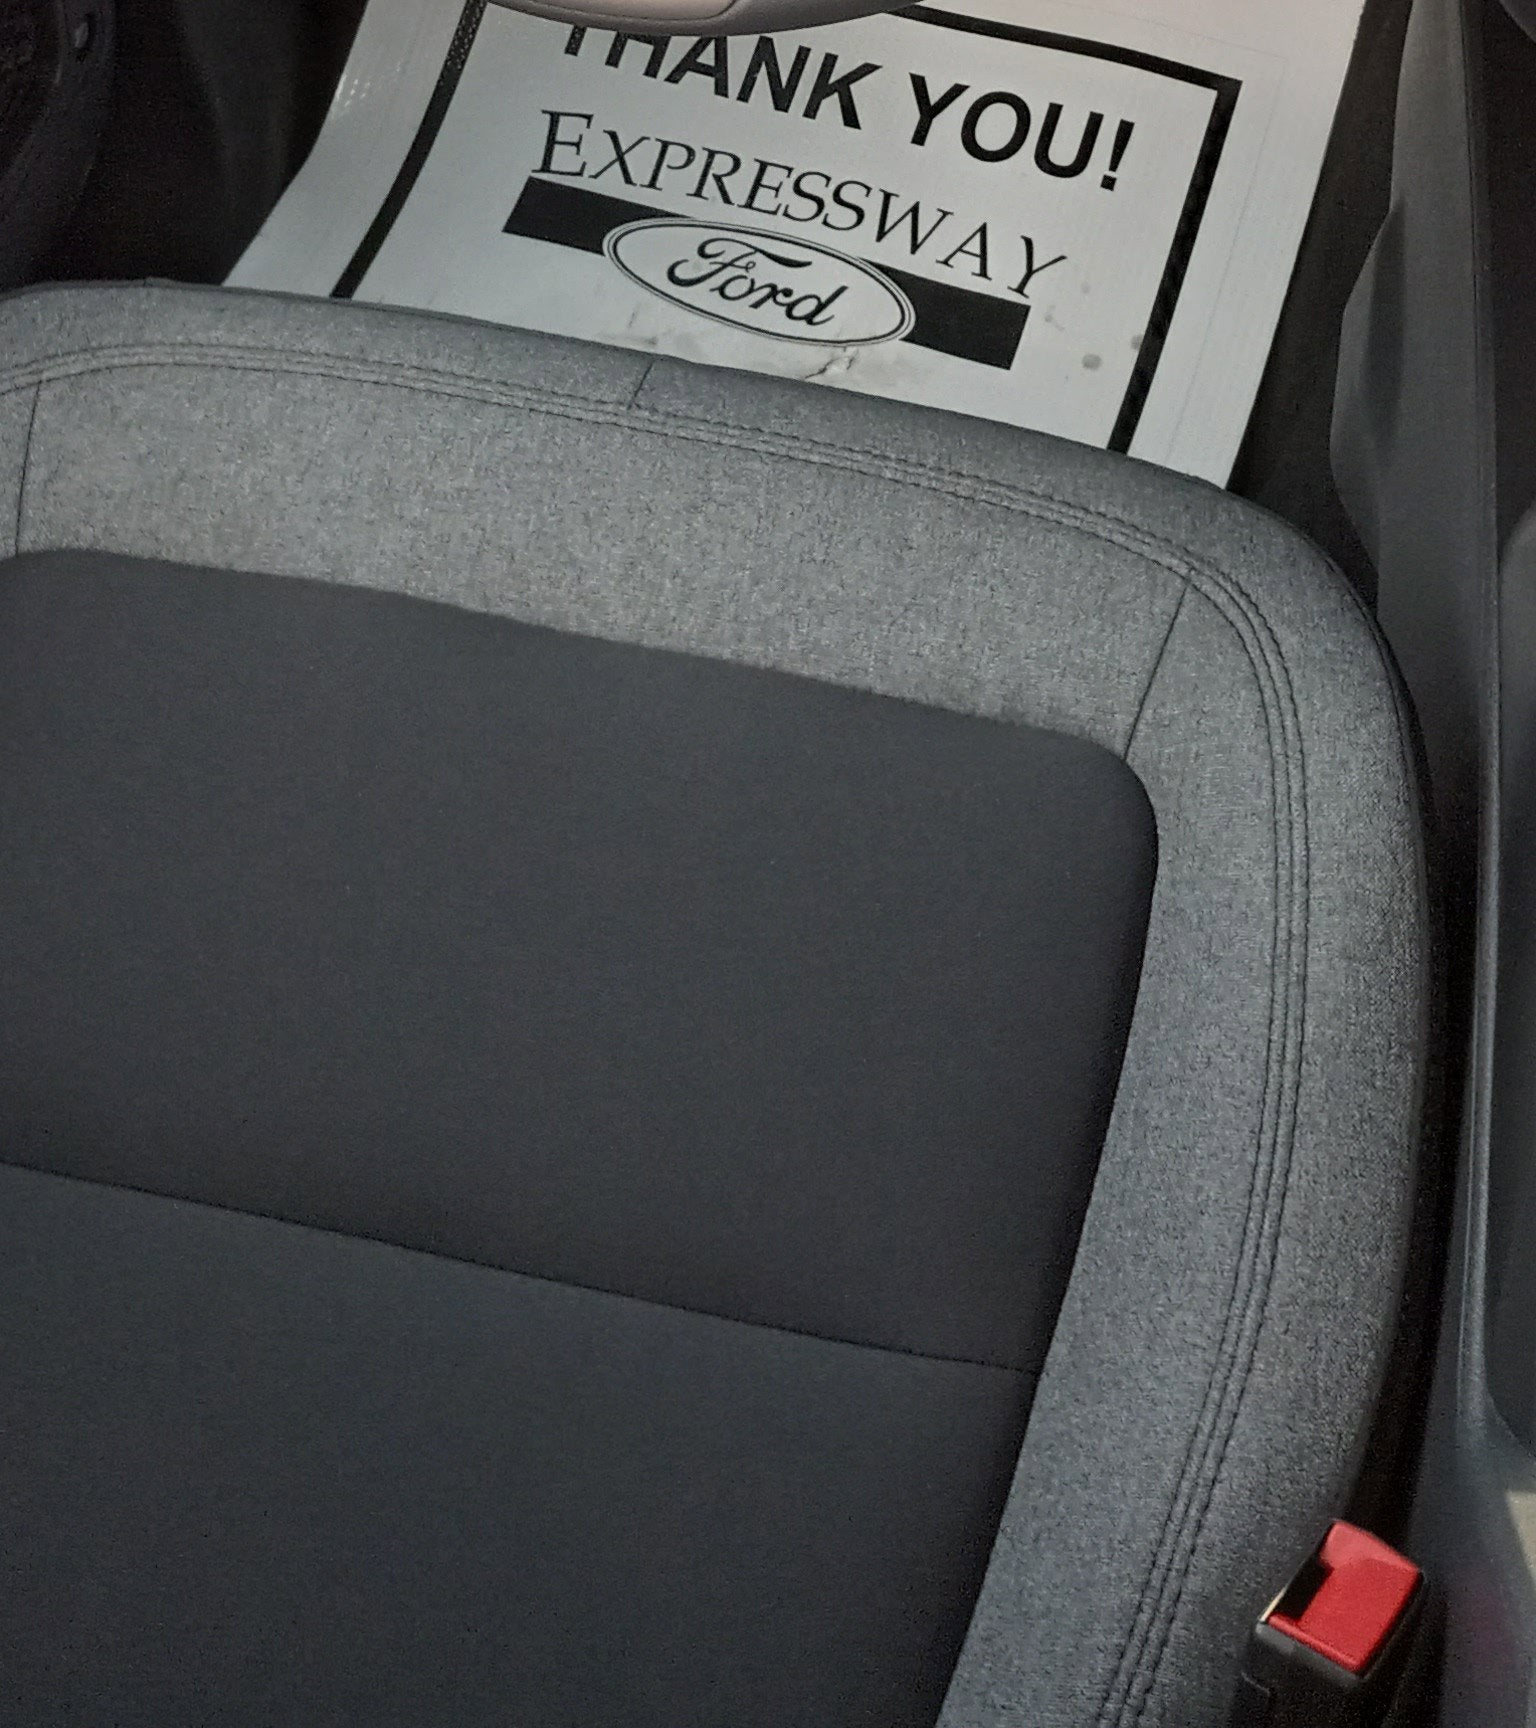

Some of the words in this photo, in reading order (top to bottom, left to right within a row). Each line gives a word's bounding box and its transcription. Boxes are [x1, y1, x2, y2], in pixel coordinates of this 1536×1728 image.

[908, 70, 1137, 192] YOU!
[532, 110, 1068, 301] EXPRESSWAY
[668, 235, 850, 328] Ford
